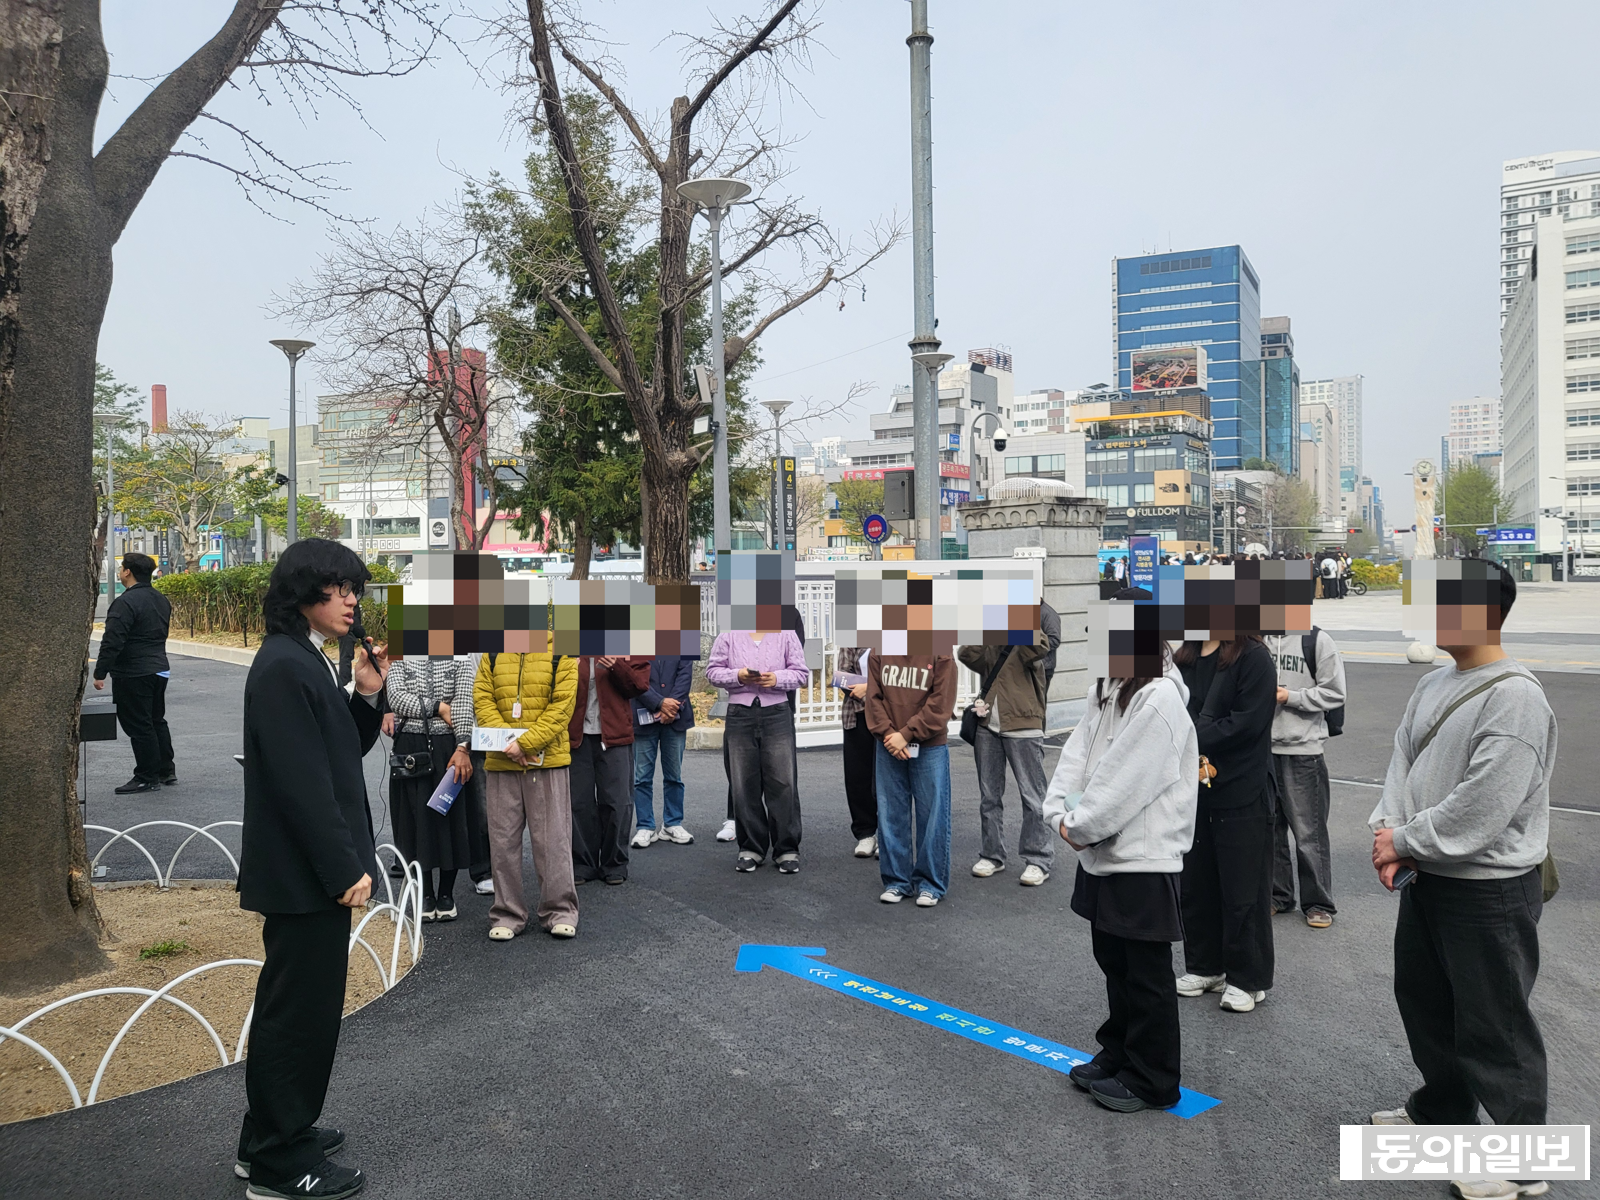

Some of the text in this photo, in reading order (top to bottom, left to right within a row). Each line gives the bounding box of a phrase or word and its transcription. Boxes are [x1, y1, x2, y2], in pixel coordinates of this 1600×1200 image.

[786, 474, 793, 483] 4
[1136, 506, 1180, 517] FULLDOM
[881, 664, 929, 691] GRAILZ
[843, 980, 929, 1012] 옛전남도청
[935, 1013, 996, 1036] 전시관
